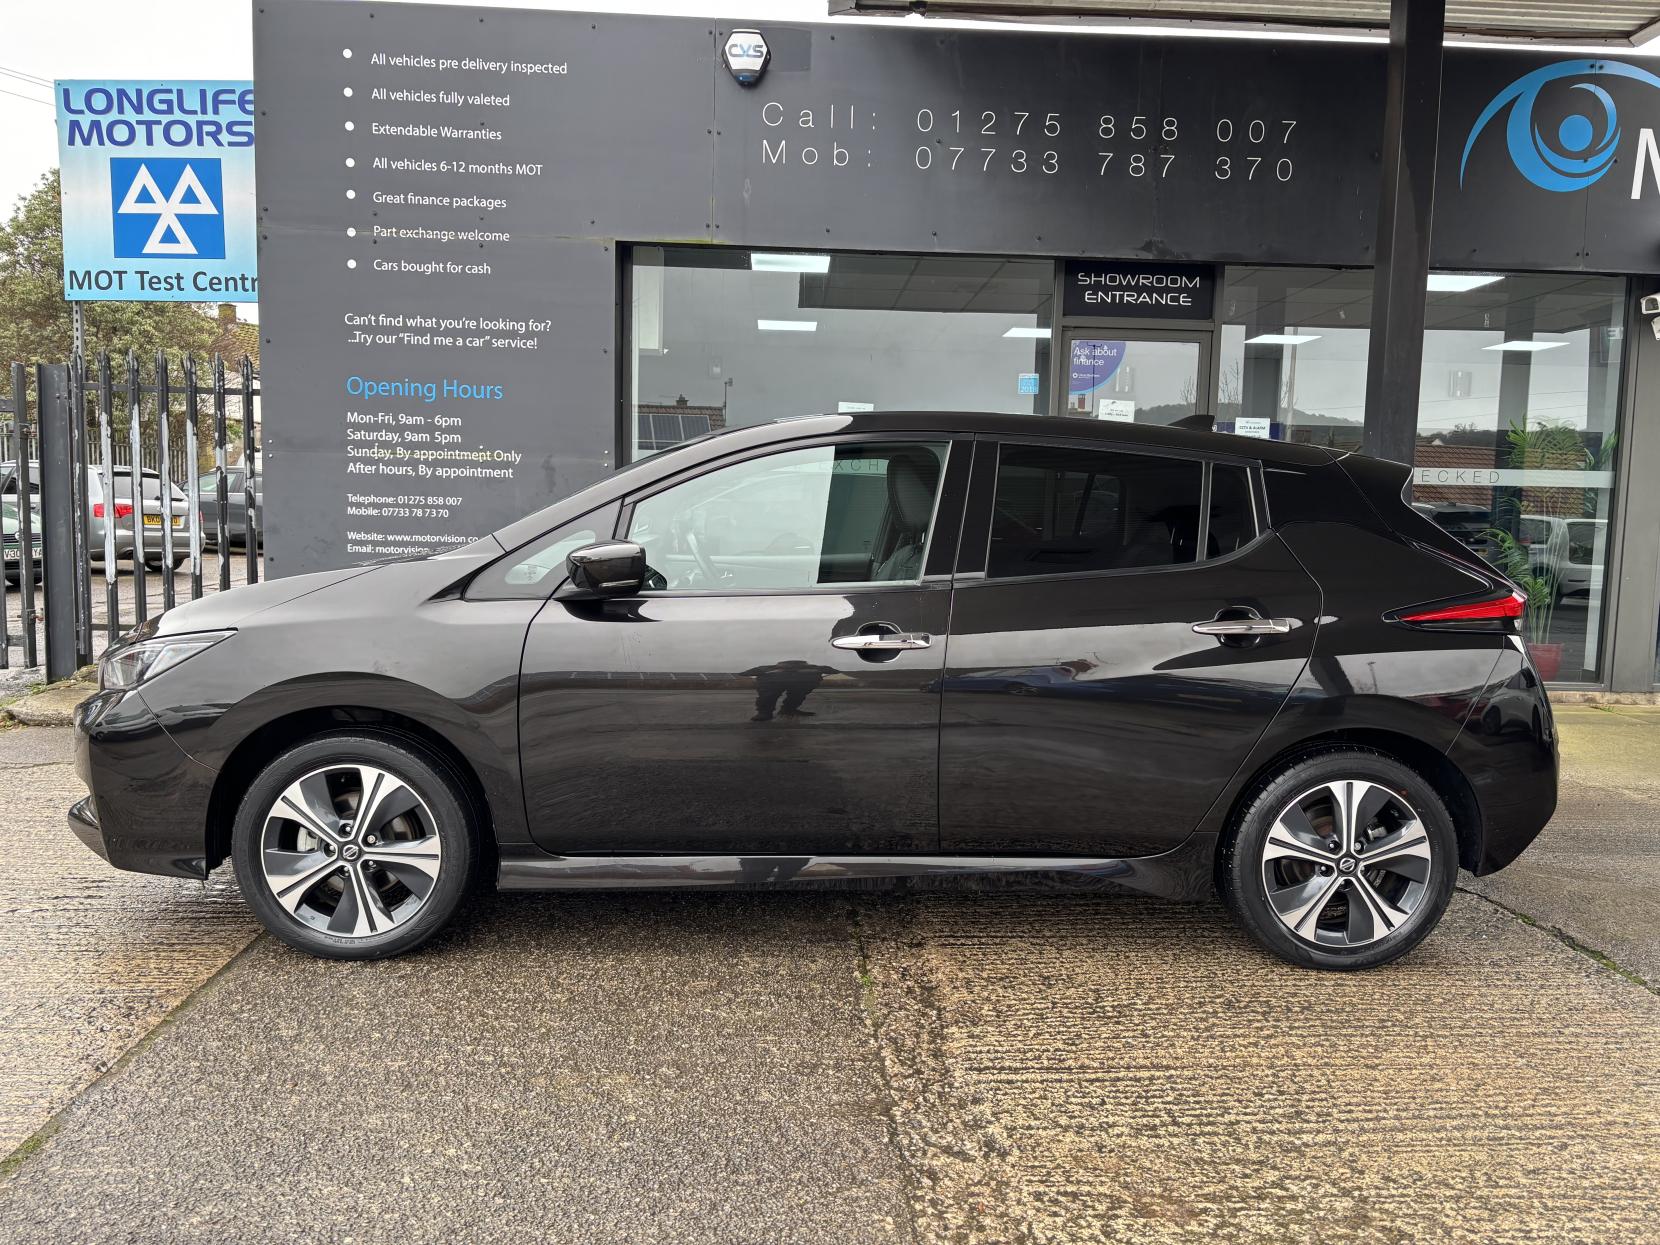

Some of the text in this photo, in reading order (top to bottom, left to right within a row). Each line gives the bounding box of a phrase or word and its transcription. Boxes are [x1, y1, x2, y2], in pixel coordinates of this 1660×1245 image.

[371, 53, 567, 75] All vehicles pre delivery inspected
[63, 88, 254, 116] LONGLIFE
[372, 88, 509, 106] All vehicles fully valeted
[373, 123, 501, 139] Extendable Warranties
[762, 102, 1297, 144] Call: 01275 858 007
[67, 119, 254, 147] MOTORS
[373, 158, 543, 175] All vehicles 6-12 months MOT
[762, 140, 1293, 181] Mob: 07733 787 370
[373, 192, 506, 210] Great finance packages
[374, 226, 509, 242] Part exchange welcome
[374, 260, 490, 274] Cars bought for cash
[69, 270, 128, 290] MOT
[134, 271, 185, 292] Test
[1077, 272, 1200, 288] SHOWROOM
[1084, 291, 1192, 305] ENTRANCE
[345, 314, 551, 333] Can’t find what you’re looking for?
[376, 335, 397, 343] our
[399, 333, 430, 344] “Find
[434, 337, 453, 345] me
[466, 336, 490, 346] car”
[492, 337, 537, 349] service!
[1074, 347, 1117, 356] Ask about
[1073, 357, 1105, 366] finance
[347, 377, 502, 402] Opening Hours
[347, 412, 395, 425] Mon-Fri,
[399, 414, 424, 424] 9am
[435, 415, 461, 428] 6pm
[347, 429, 461, 445] Saturday, 9am 5pm
[347, 446, 521, 464] Sunday, By appointment Only
[347, 462, 513, 478] After hours, By appointment
[347, 494, 462, 505] Telephone: 01275 858 007
[348, 507, 380, 515] Mobile:
[382, 508, 409, 516] 07733
[347, 532, 385, 540] Website:
[348, 544, 374, 553] Email:
